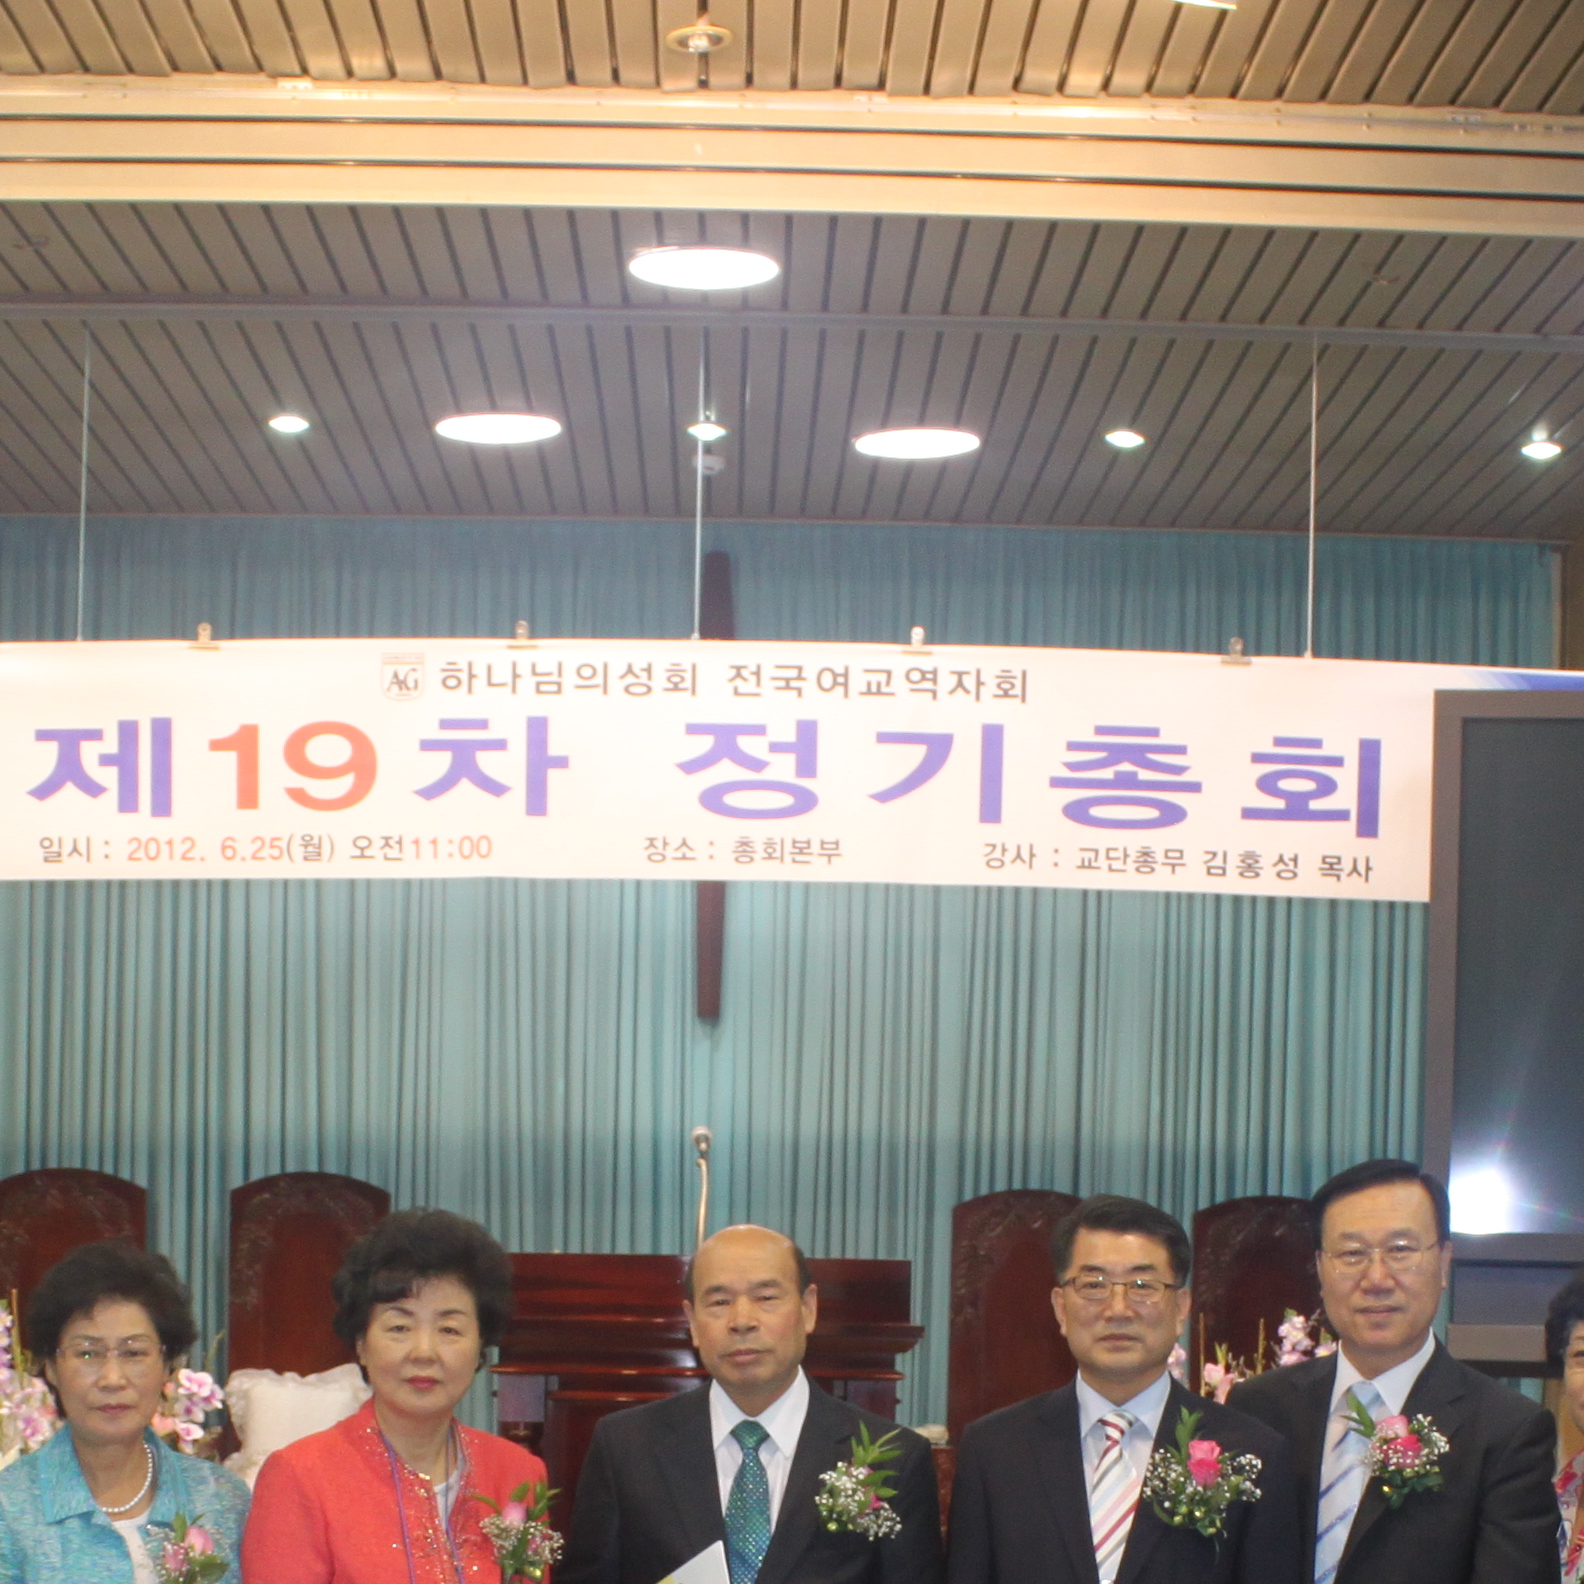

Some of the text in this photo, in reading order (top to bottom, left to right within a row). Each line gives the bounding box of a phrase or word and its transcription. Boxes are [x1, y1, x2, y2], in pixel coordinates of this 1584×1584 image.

[439, 661, 698, 697] 하나님의성회
[25, 715, 1382, 839] 제19차 정기총회
[126, 837, 207, 862] 2012.
[732, 836, 843, 865] 총회본부
[1076, 846, 1187, 875] 교단총무
[1318, 855, 1374, 884] 목사
